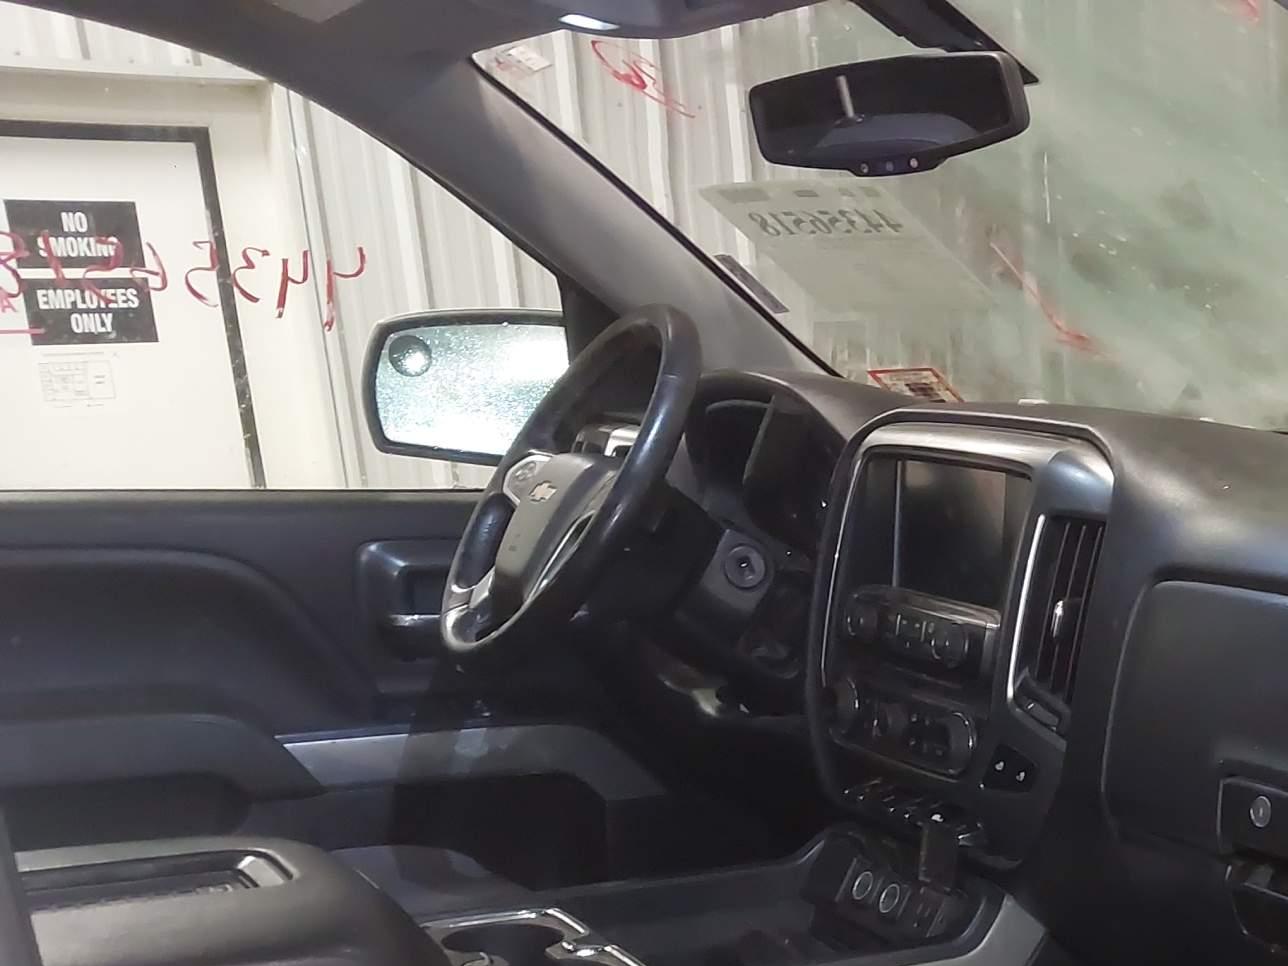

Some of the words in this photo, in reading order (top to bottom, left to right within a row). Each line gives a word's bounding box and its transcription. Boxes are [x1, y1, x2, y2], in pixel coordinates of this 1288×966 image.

[60, 211, 88, 233] NO
[36, 288, 140, 310] EMPLOYEES
[70, 312, 113, 334] ONLY
